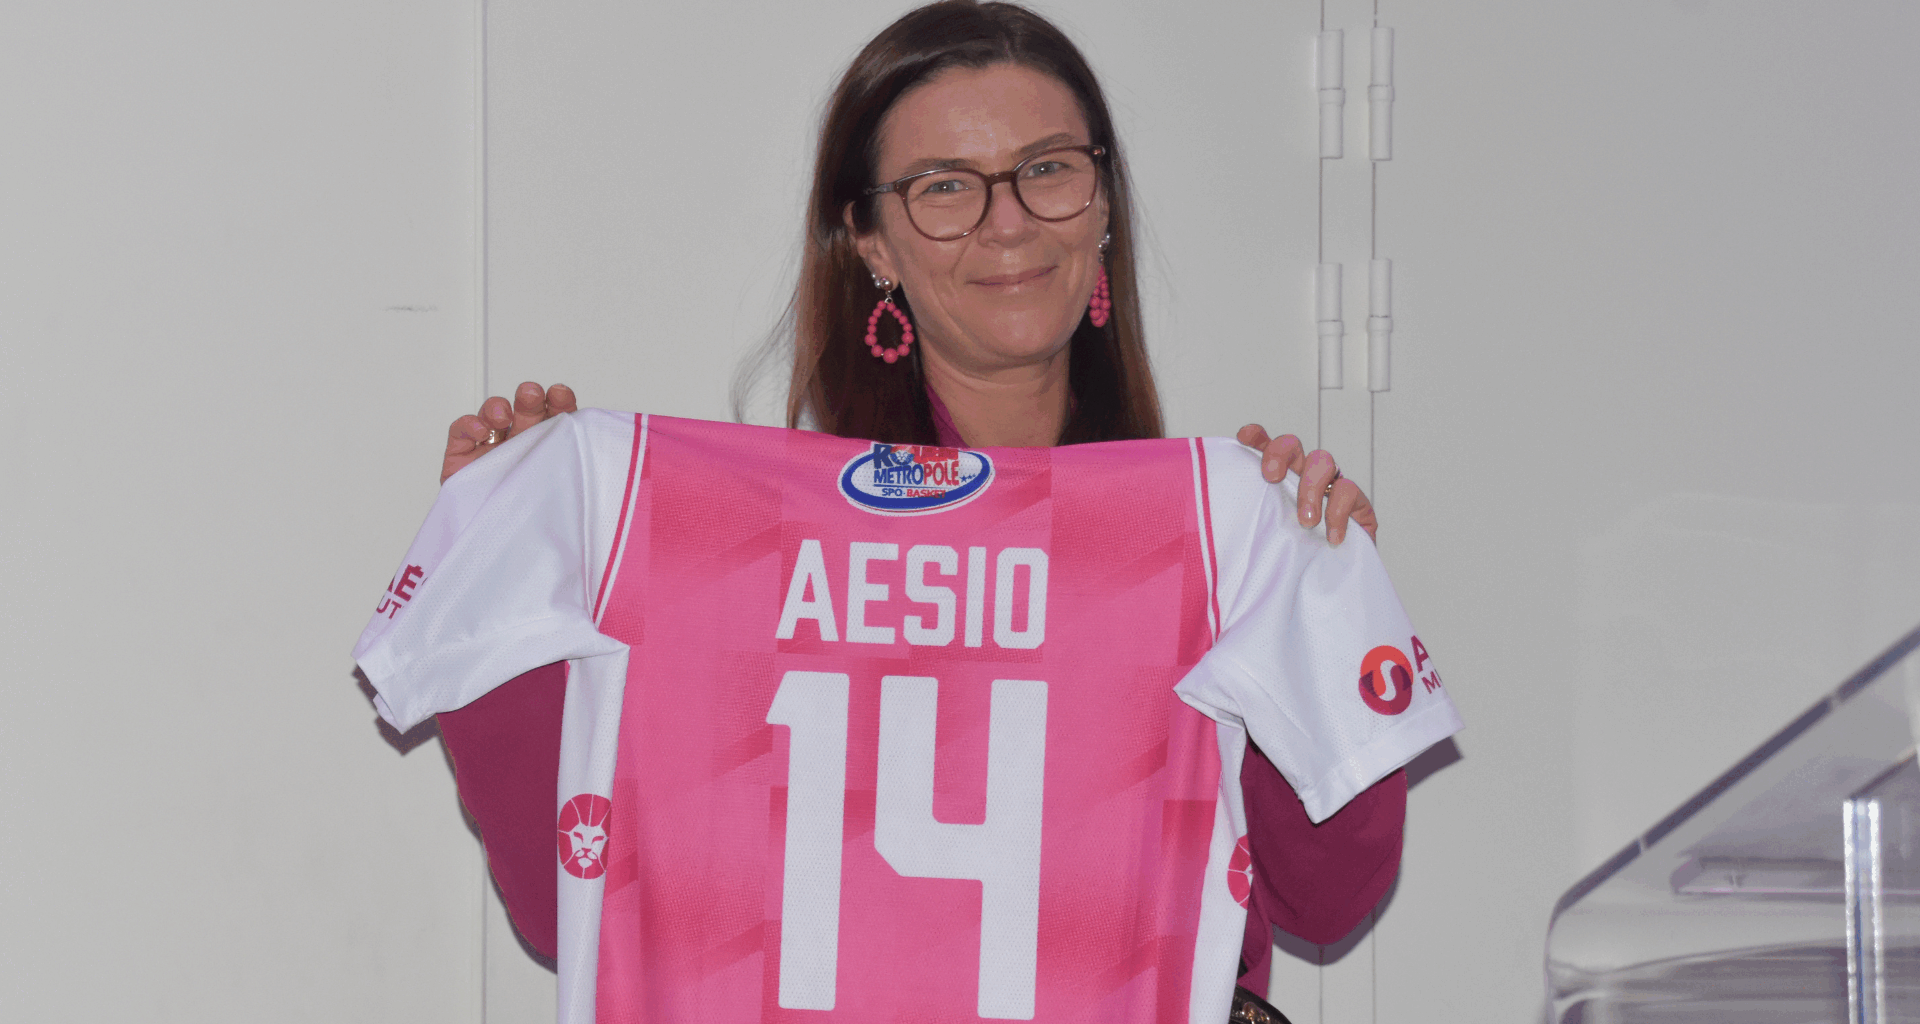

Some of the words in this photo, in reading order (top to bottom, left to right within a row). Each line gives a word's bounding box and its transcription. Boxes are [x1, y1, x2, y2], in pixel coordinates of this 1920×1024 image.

[874, 461, 960, 486] METROPOLE
[387, 564, 424, 602] É
[774, 539, 1049, 649] AESIO
[765, 670, 1048, 1021] 14
